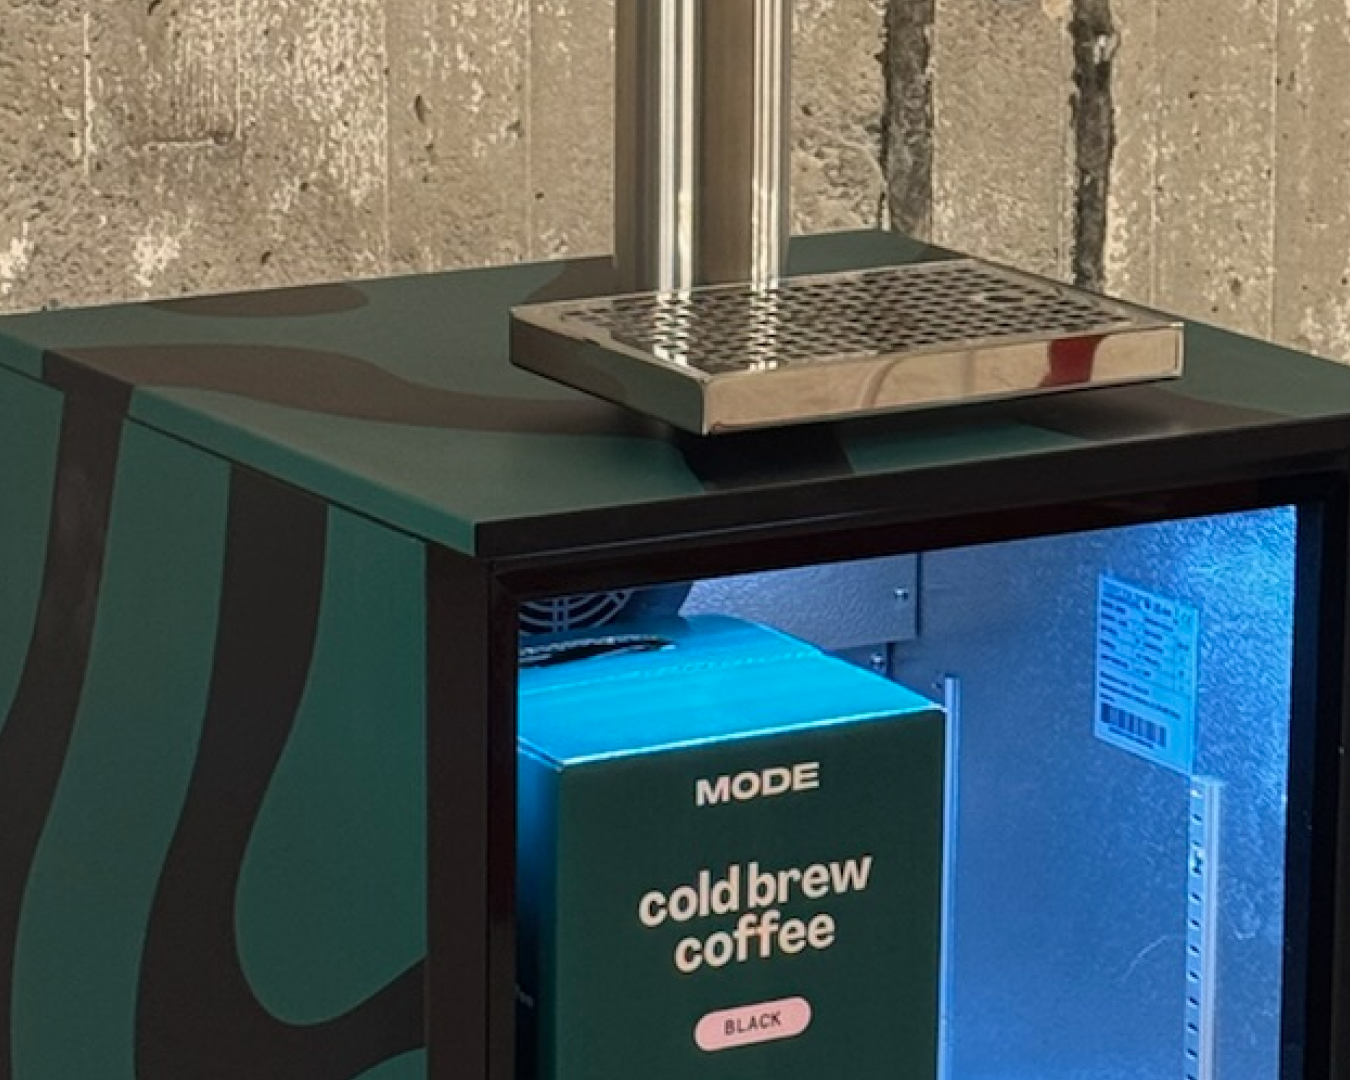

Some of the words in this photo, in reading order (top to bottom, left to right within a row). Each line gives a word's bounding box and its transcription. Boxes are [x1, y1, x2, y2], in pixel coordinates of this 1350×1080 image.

[695, 761, 820, 806] MODE
[638, 864, 740, 927] cold
[747, 855, 873, 909] brew
[674, 908, 836, 973] coffee
[724, 1011, 782, 1036] BLACK
